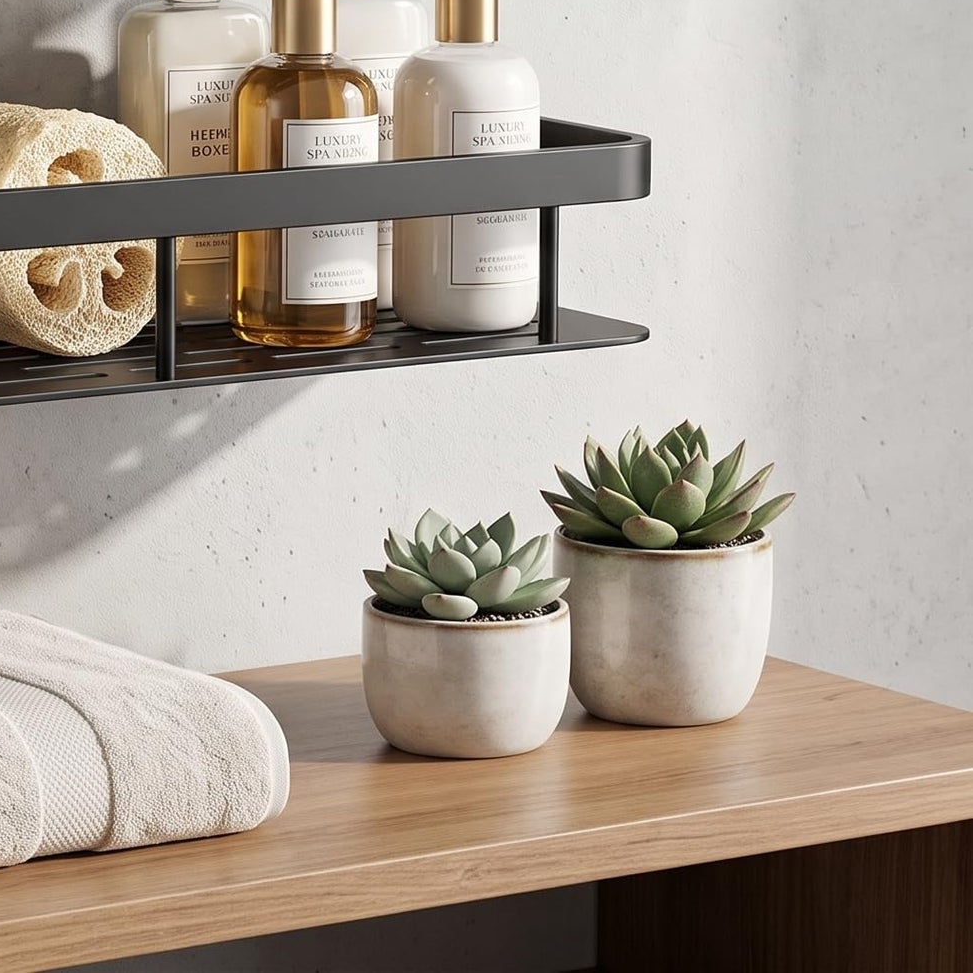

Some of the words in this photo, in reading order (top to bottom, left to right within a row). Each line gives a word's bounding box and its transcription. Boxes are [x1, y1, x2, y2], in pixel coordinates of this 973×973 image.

[189, 93, 212, 105] SPA
[480, 121, 526, 134] LUXURY
[315, 133, 363, 147] LUXURY
[472, 135, 495, 147] SPA
[306, 148, 330, 160] SPA
